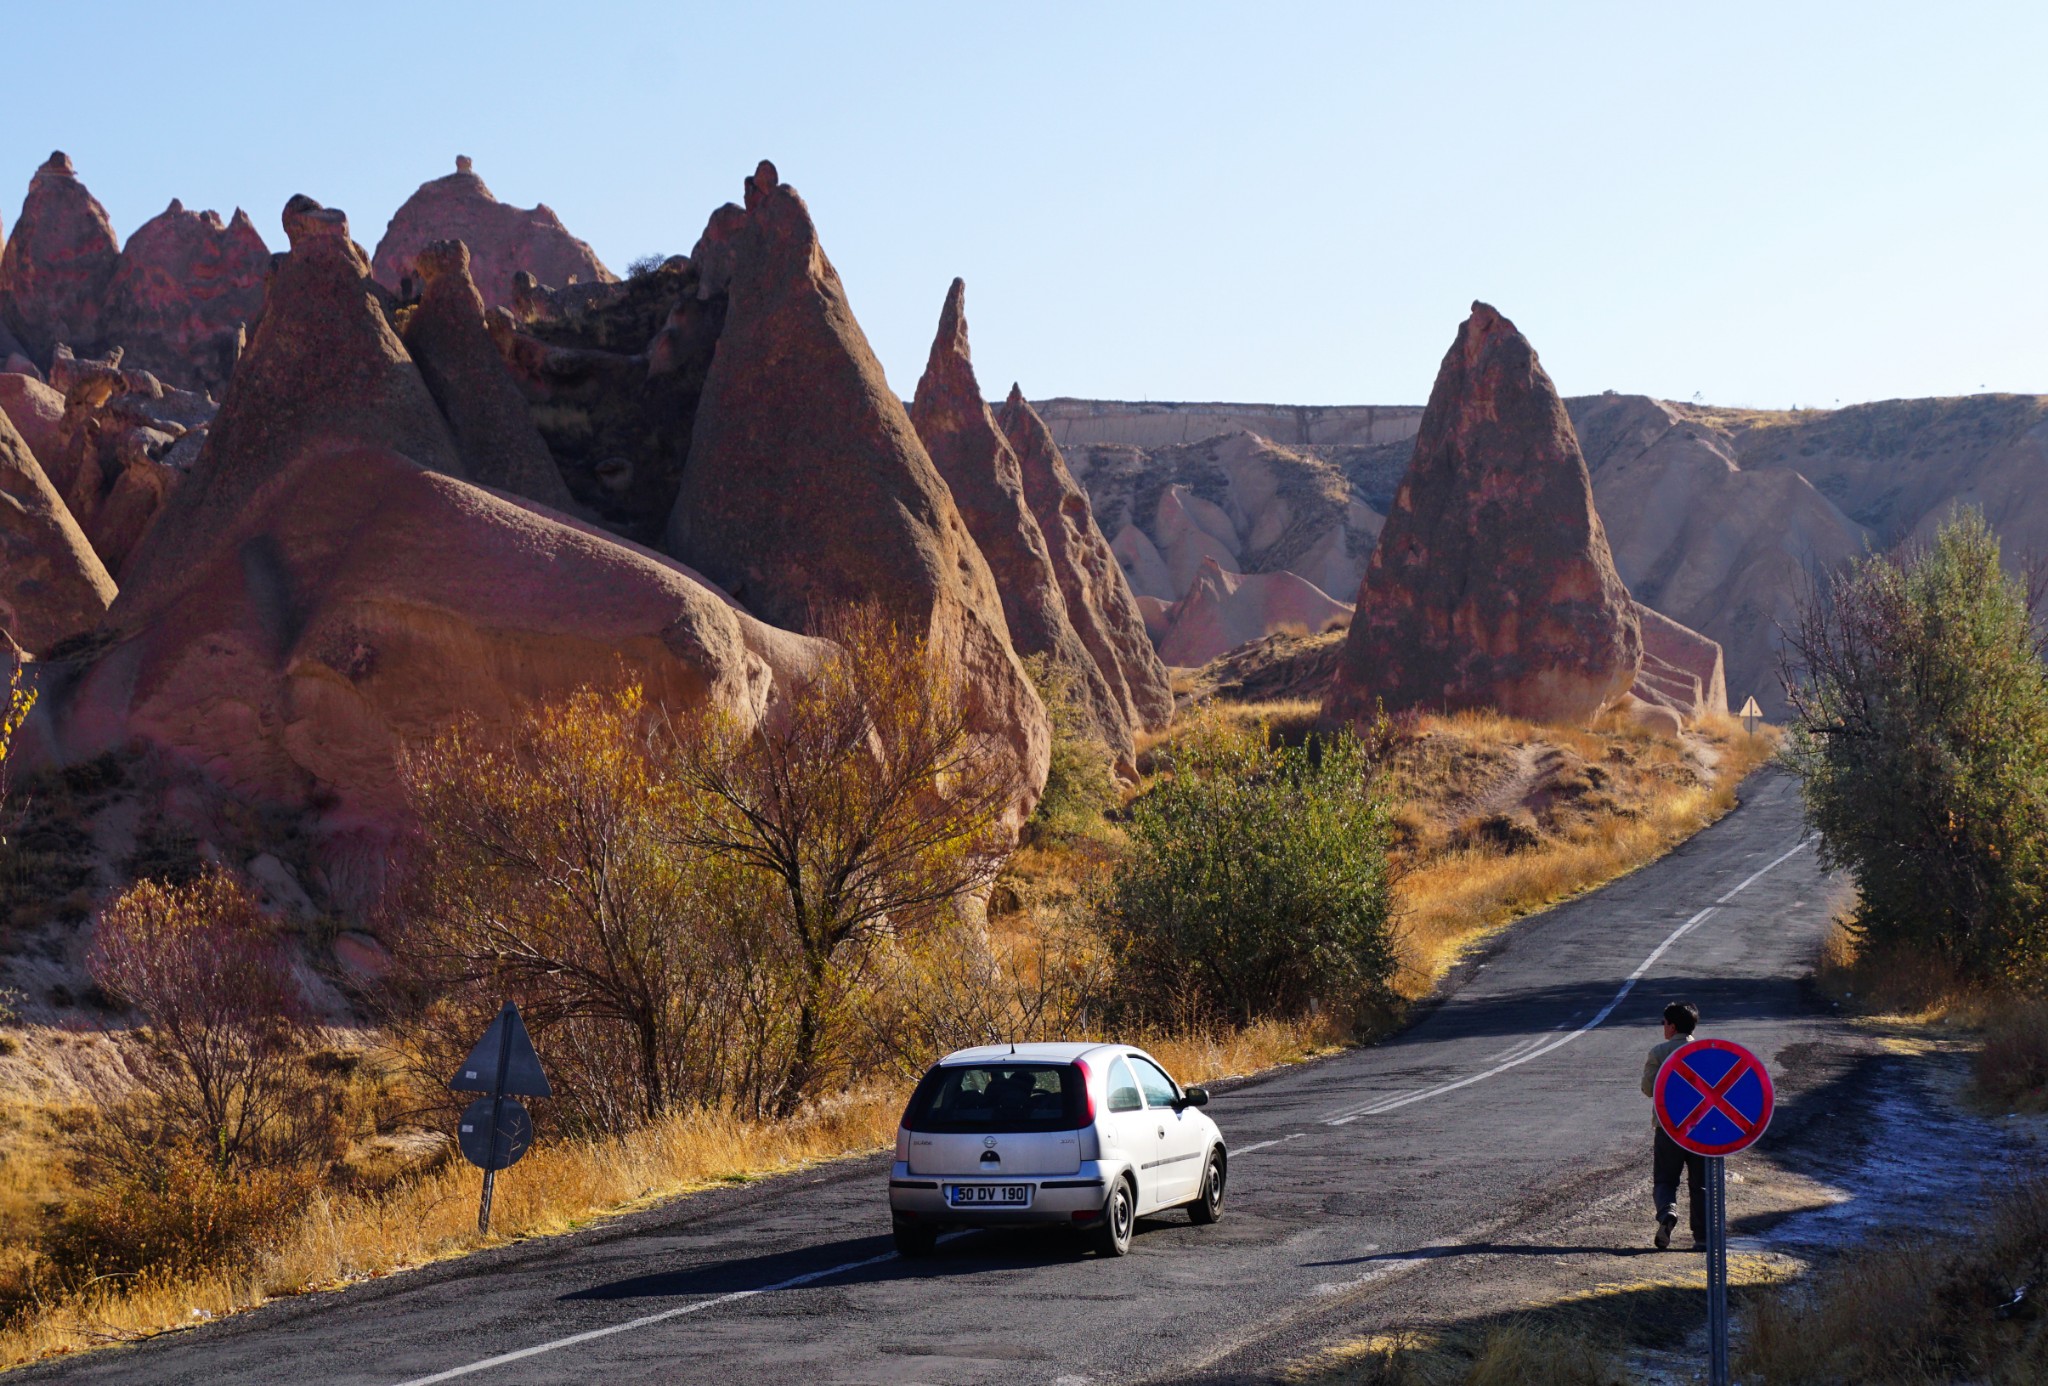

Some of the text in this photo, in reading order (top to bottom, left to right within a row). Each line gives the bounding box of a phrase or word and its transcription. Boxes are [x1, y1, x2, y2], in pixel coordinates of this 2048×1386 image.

[958, 1187, 1024, 1201] 50 DV 190
